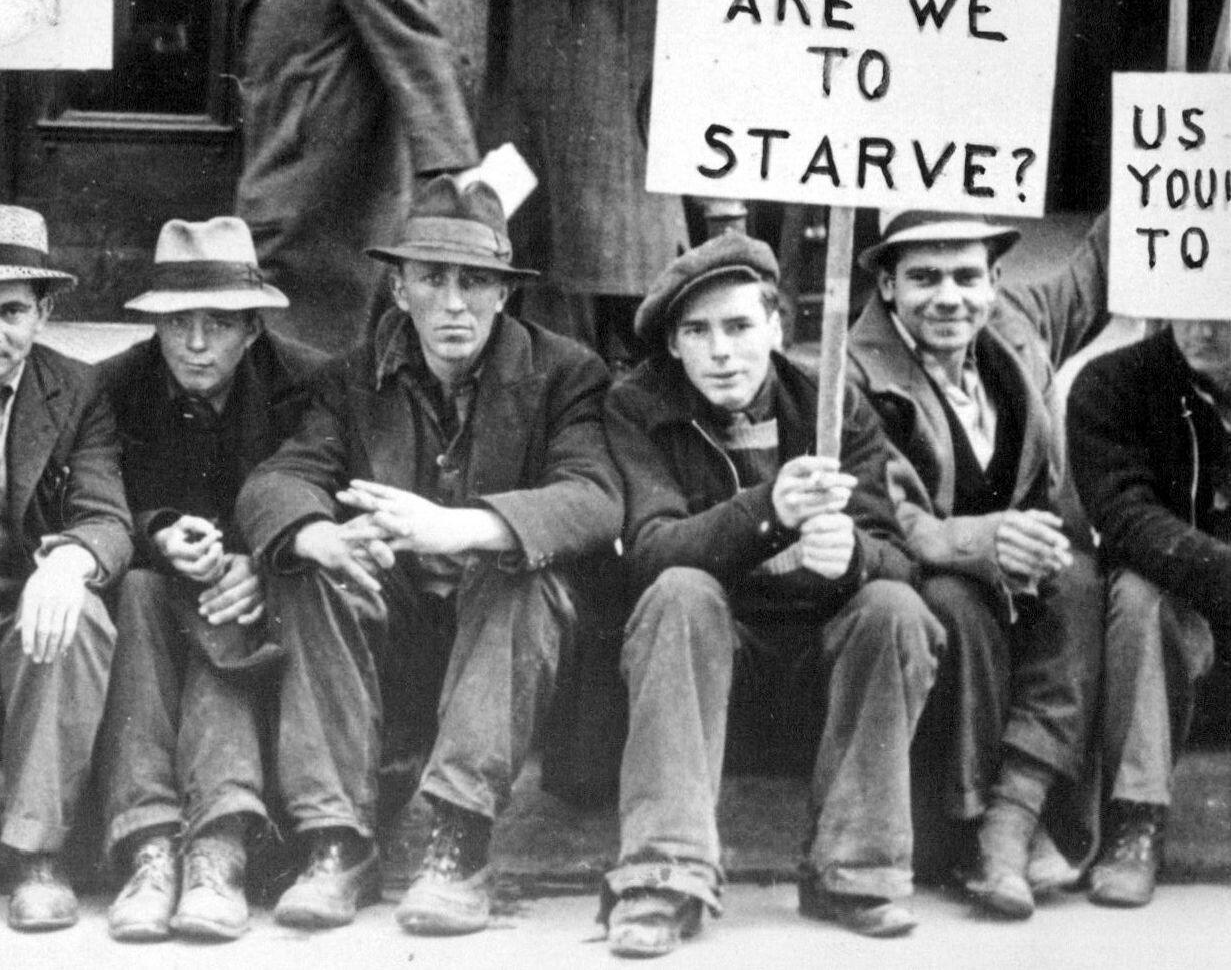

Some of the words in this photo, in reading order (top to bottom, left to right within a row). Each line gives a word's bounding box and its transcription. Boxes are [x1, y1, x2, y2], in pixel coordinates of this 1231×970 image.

[807, 46, 891, 101] TO
[1132, 104, 1207, 152] US
[697, 123, 1037, 203] STARVE?
[1136, 226, 1210, 270] TO
